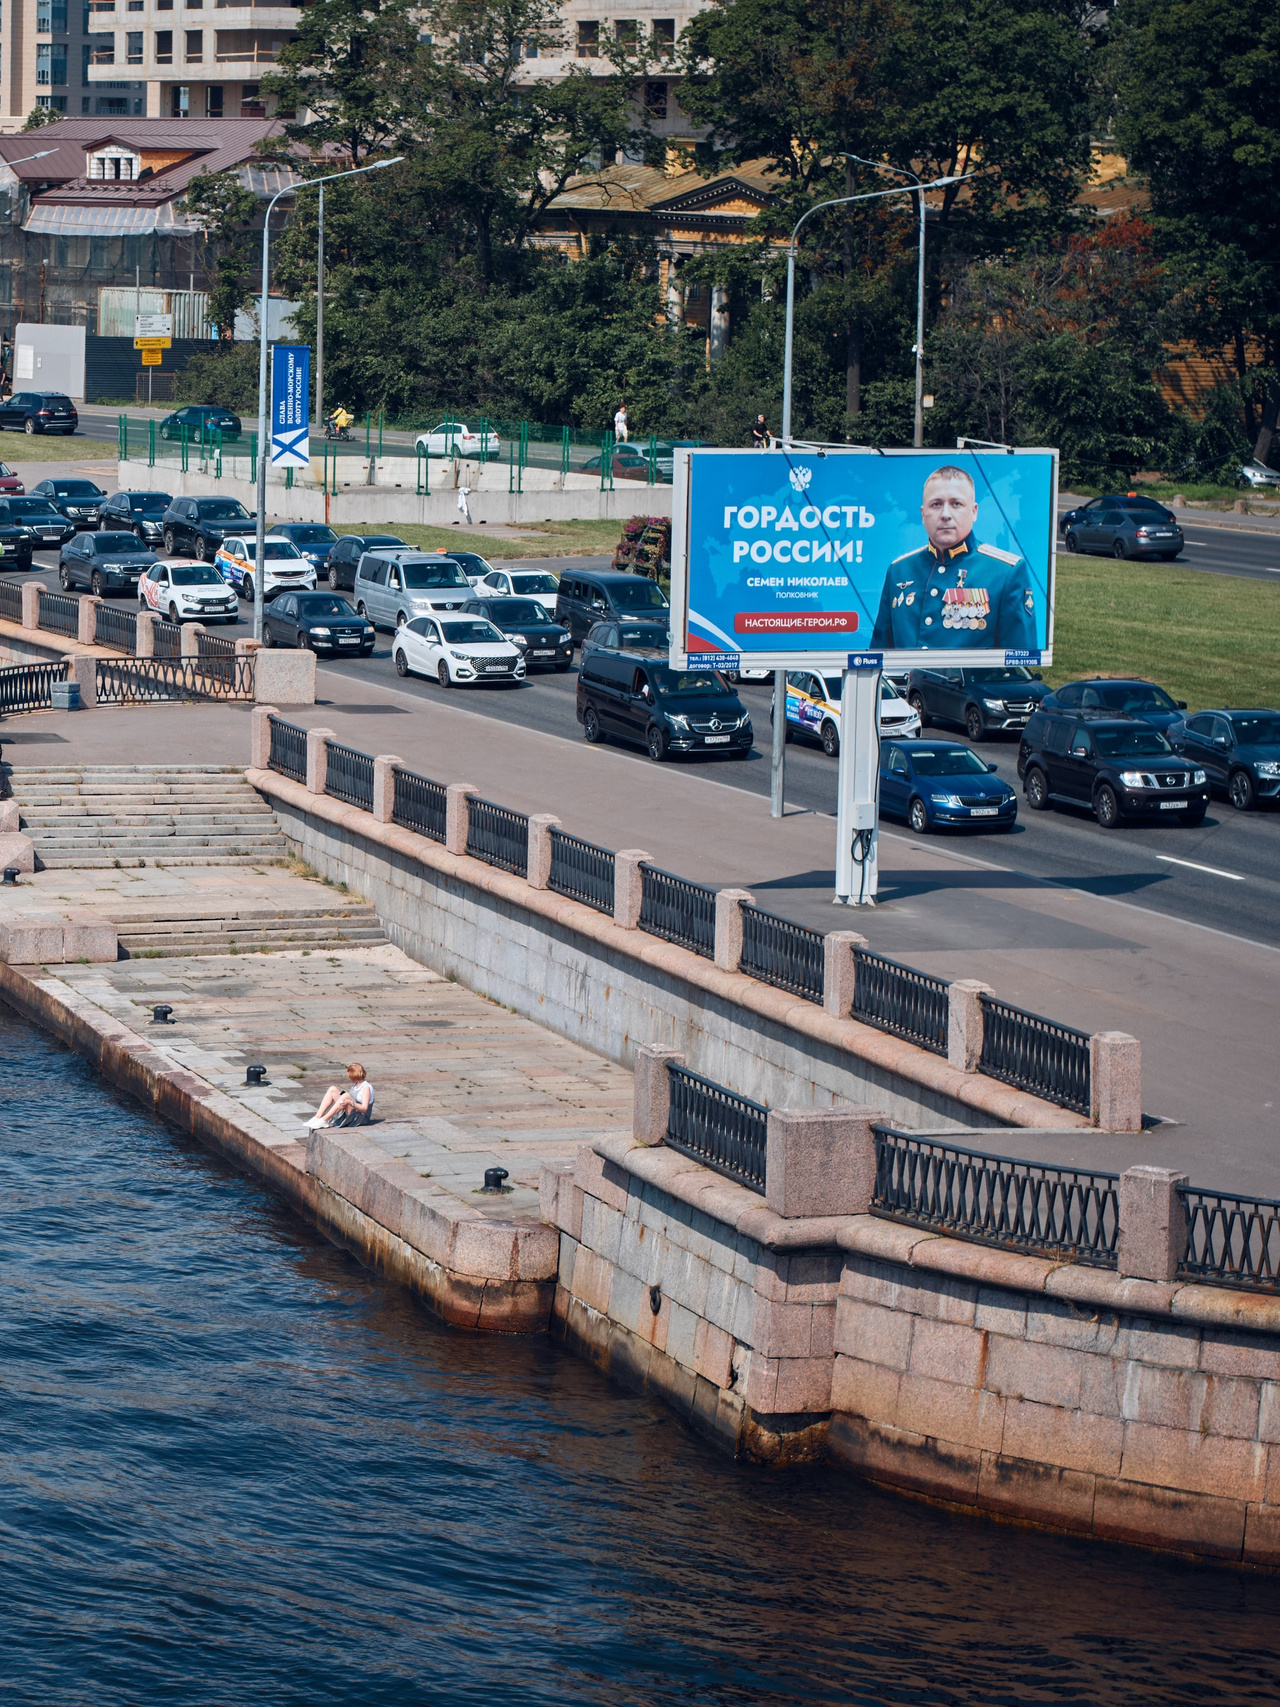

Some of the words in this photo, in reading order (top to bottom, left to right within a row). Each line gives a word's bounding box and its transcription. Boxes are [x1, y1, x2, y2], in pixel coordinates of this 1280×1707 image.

[723, 505, 875, 531] ГОРДОСТЬ
[733, 539, 863, 563] РОССИИ!
[746, 577, 784, 587] СЕМЕН
[787, 576, 849, 586] НИКОЛАЕВ
[775, 591, 819, 599] ПОЛКОВНИК
[744, 618, 848, 628] НАСТОЯЩИЕ-ГЕРОИ.РФ
[863, 657, 878, 665] Russ
